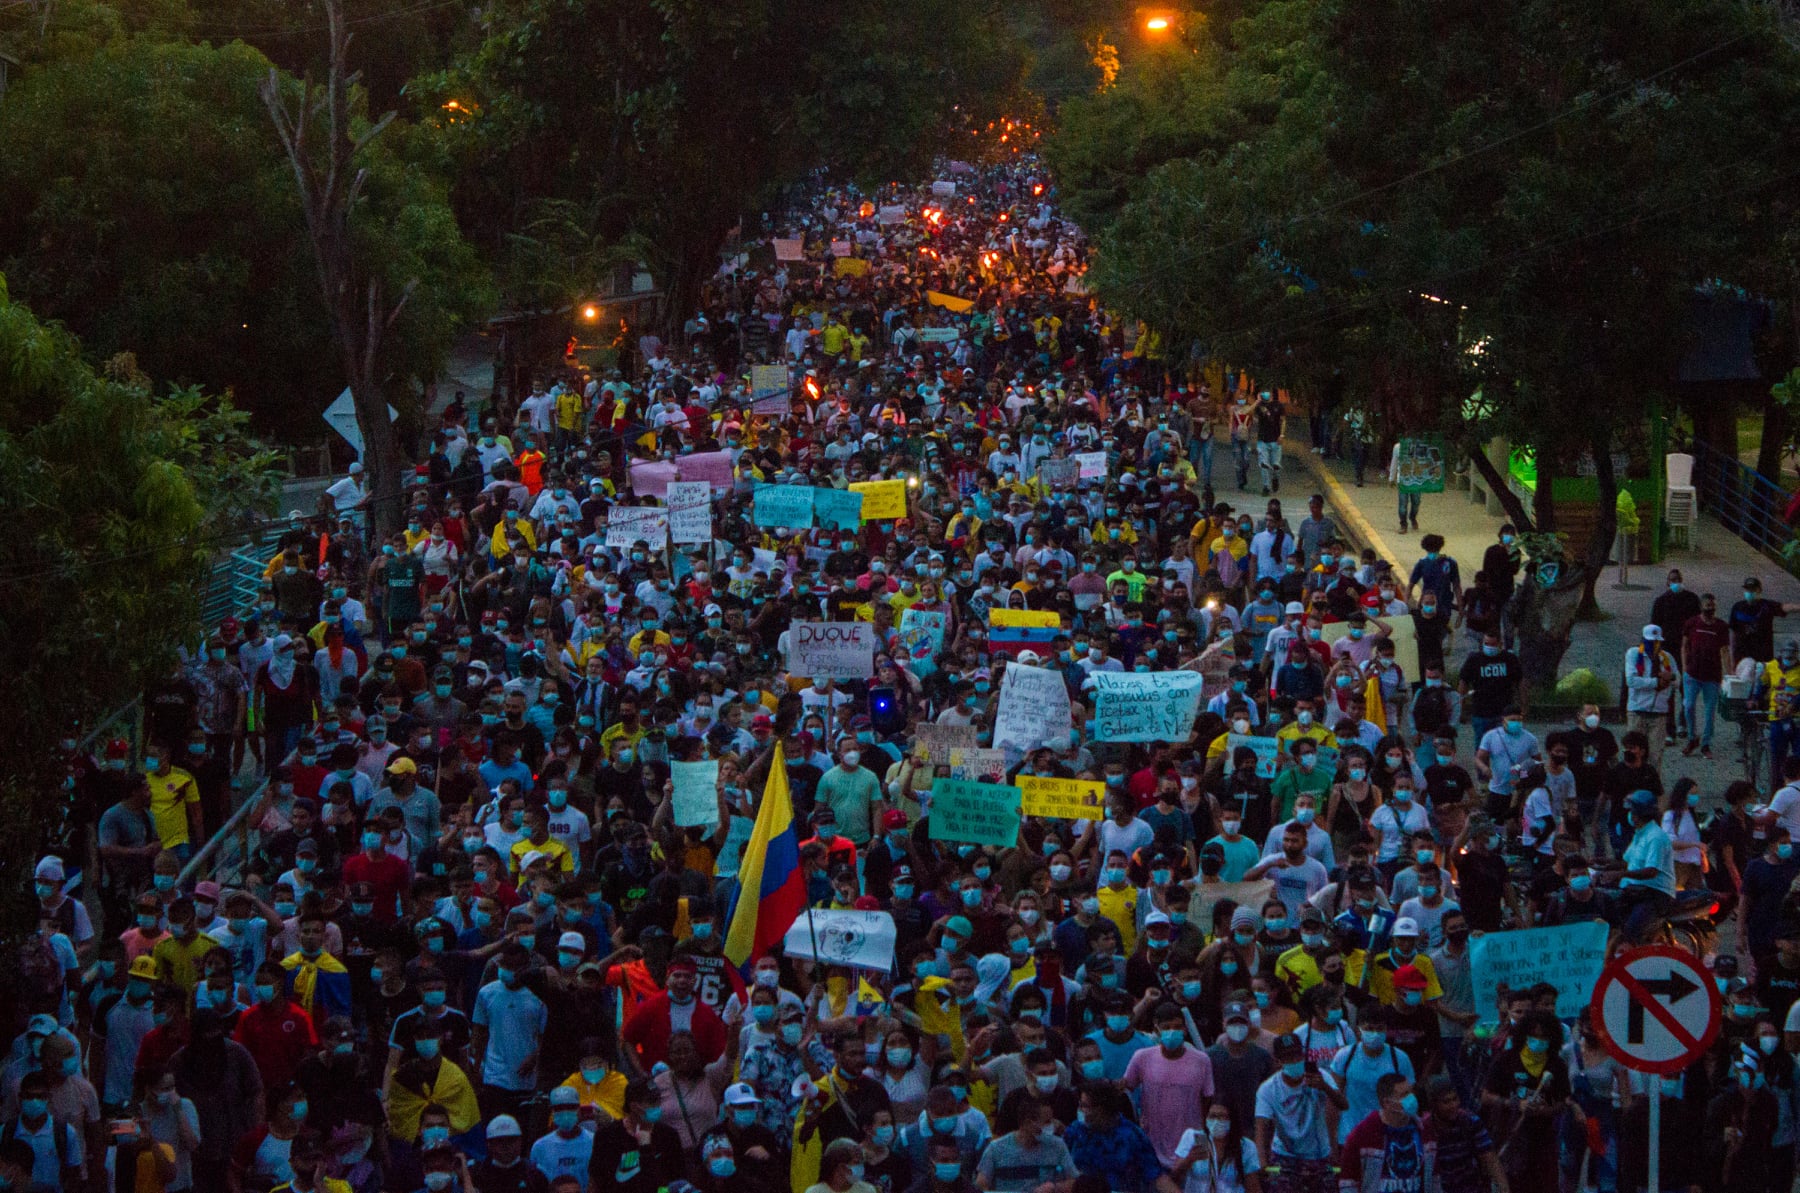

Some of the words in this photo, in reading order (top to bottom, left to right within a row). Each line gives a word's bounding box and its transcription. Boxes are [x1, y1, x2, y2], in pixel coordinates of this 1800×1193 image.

[611, 508, 626, 520] NO
[798, 625, 862, 645] DUQUE
[1480, 662, 1508, 678] ICON
[1166, 688, 1190, 700] con
